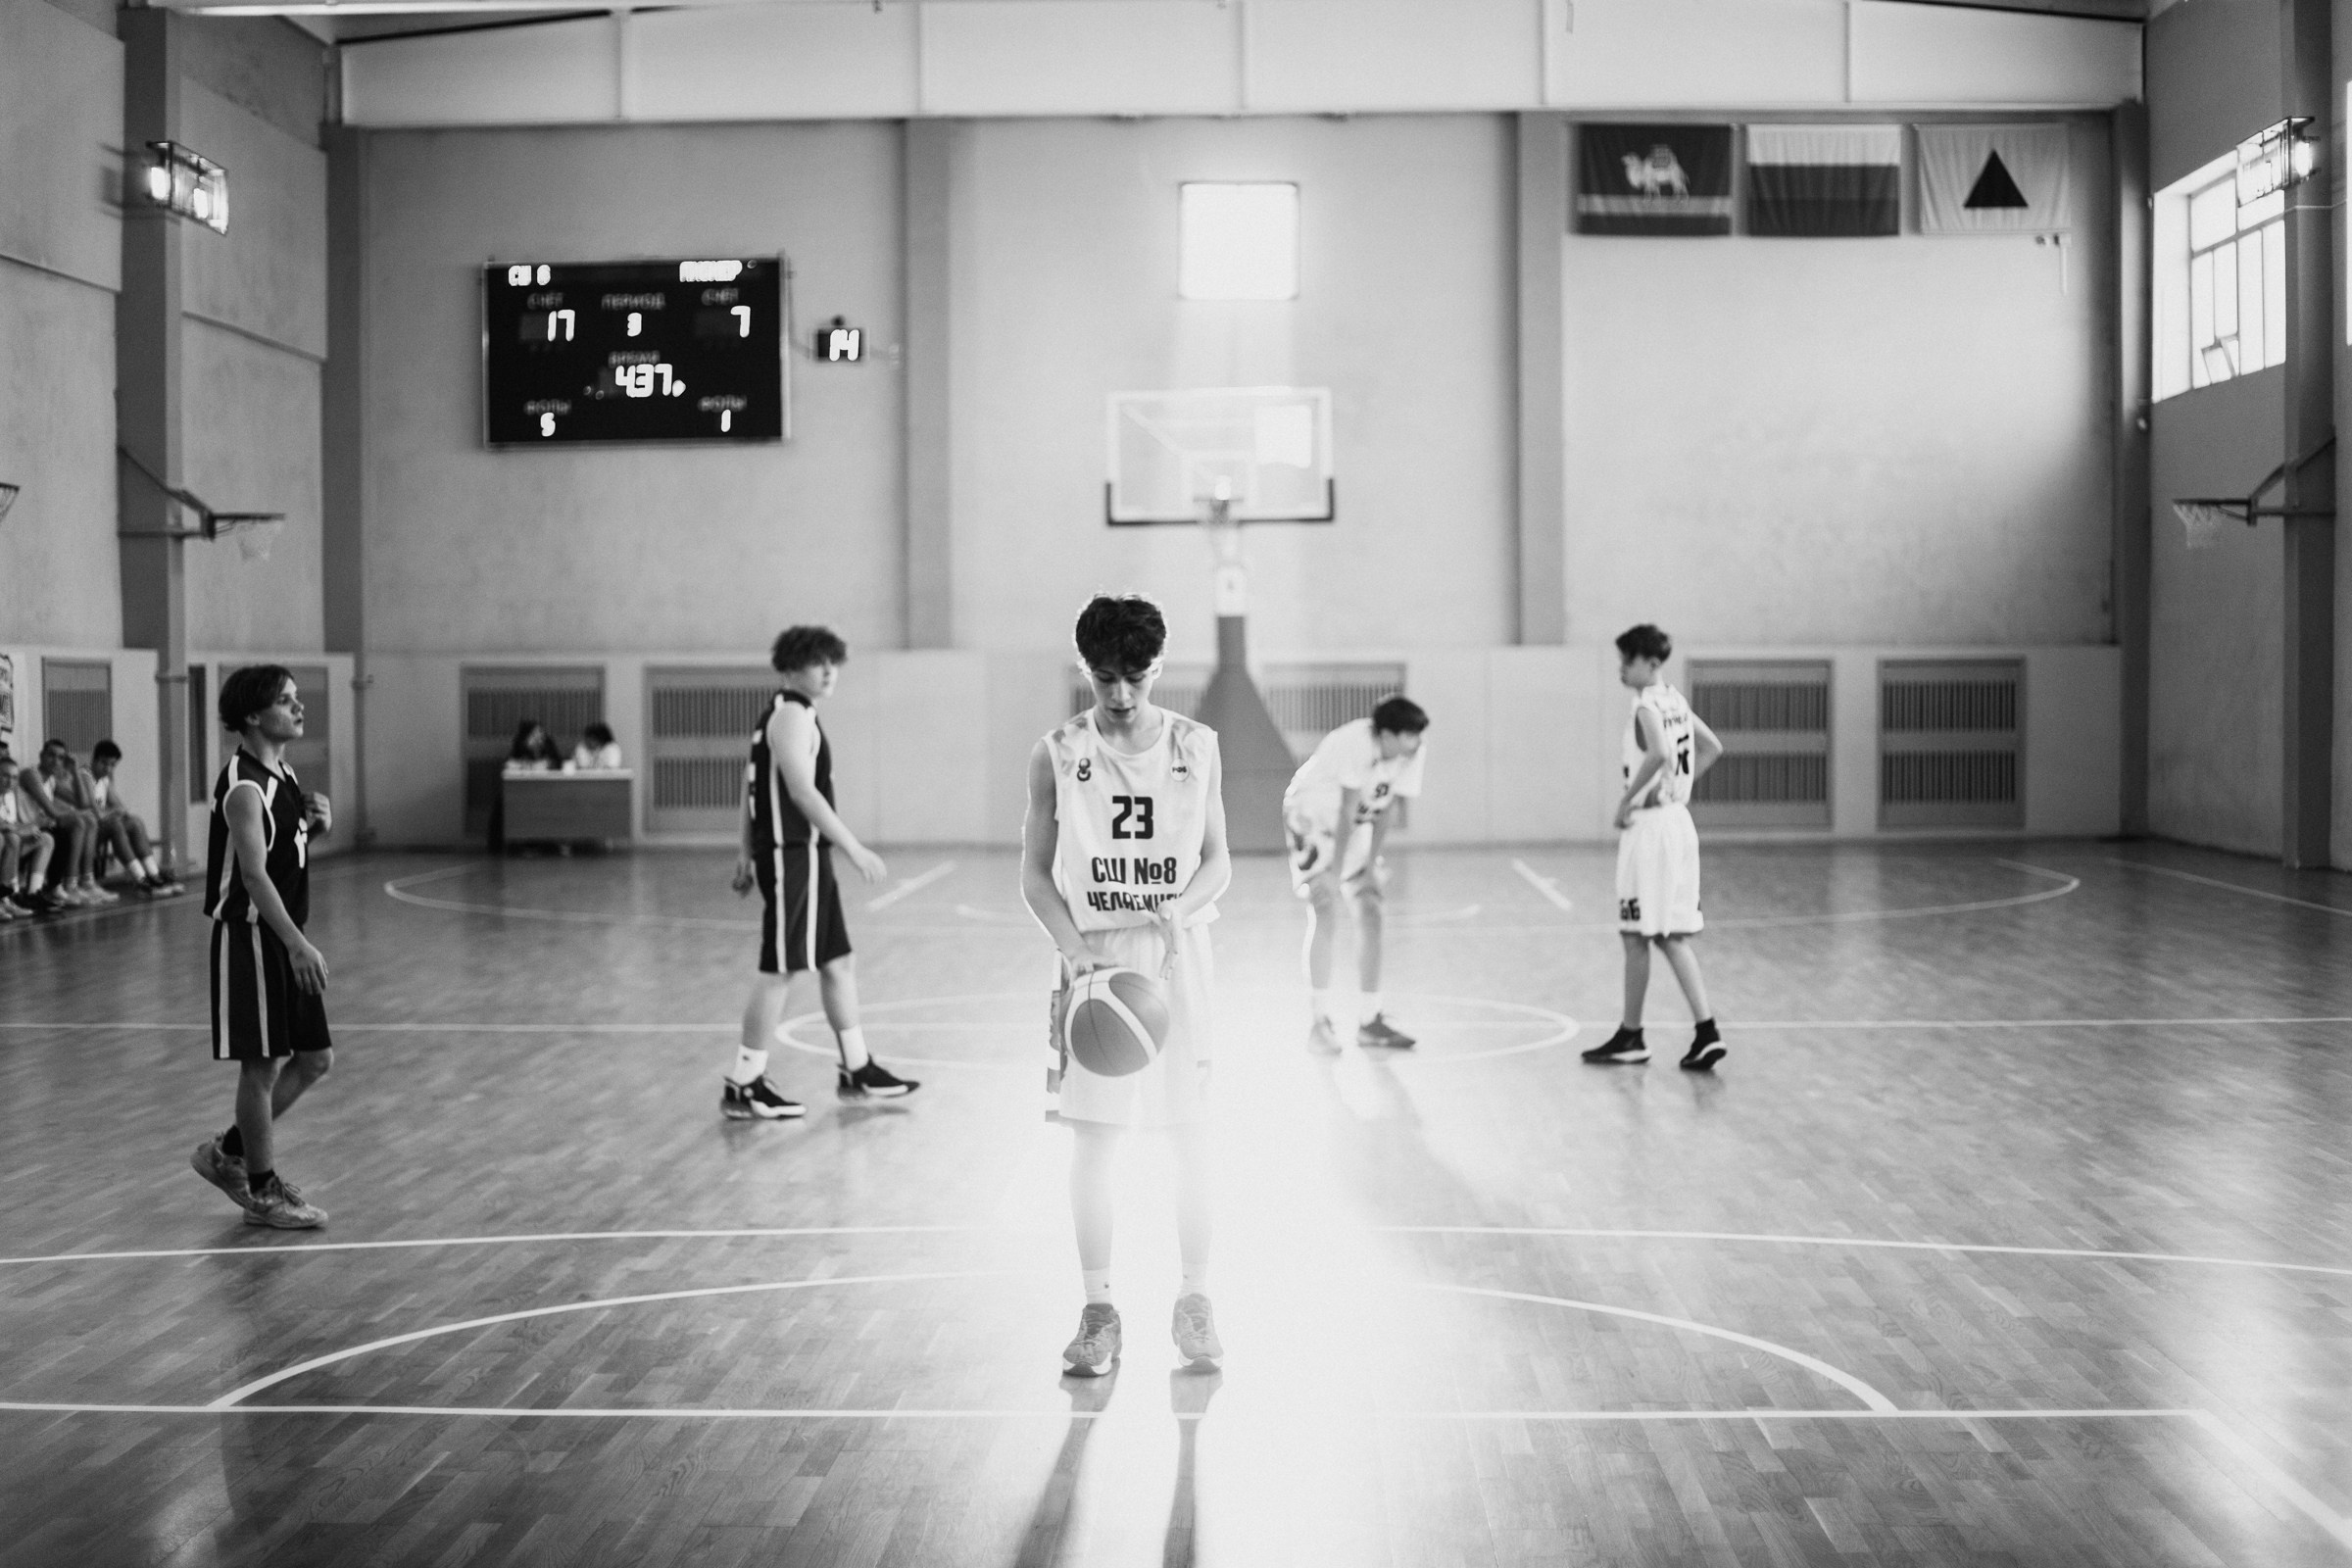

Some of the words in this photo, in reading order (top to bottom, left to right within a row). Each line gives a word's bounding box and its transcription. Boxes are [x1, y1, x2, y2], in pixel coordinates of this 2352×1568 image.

[548, 310, 575, 342] 17
[730, 305, 751, 338] 7
[1112, 795, 1154, 840] 23
[1091, 857, 1126, 884] СШ
